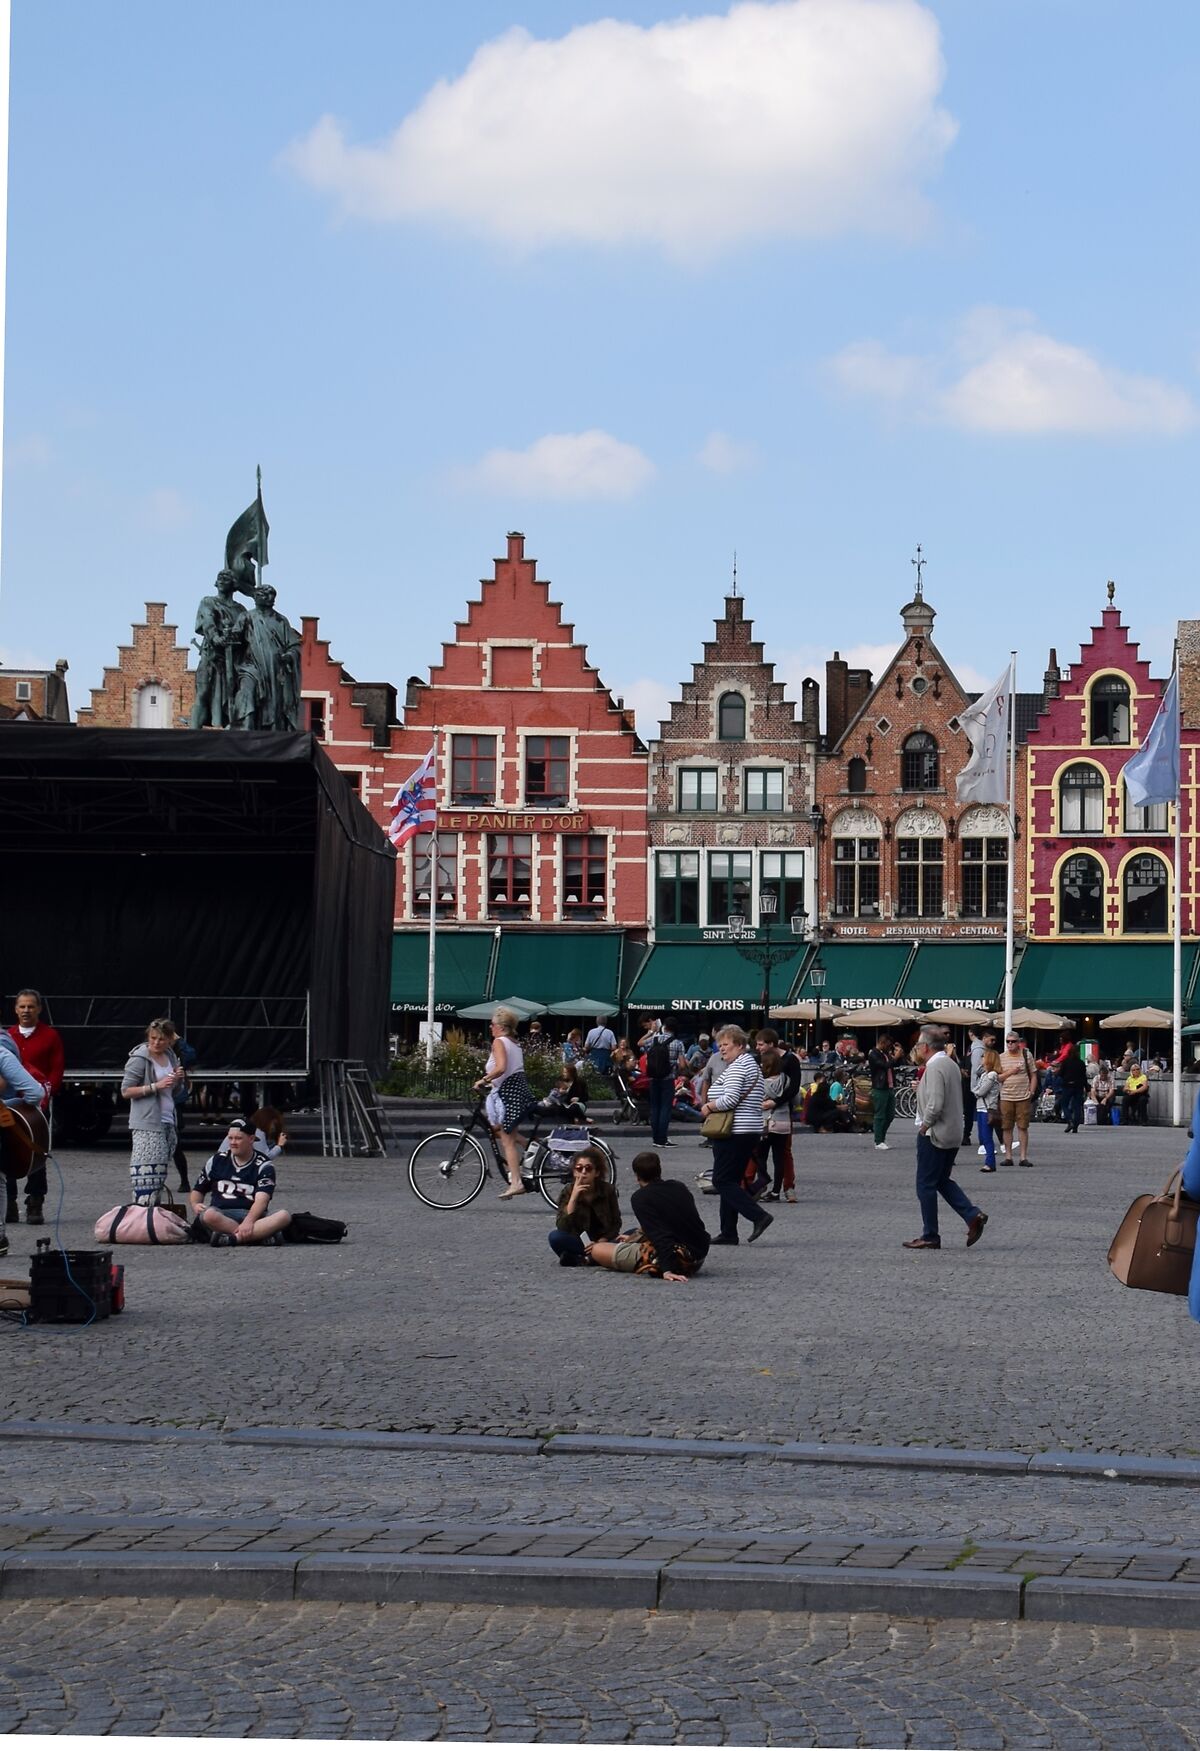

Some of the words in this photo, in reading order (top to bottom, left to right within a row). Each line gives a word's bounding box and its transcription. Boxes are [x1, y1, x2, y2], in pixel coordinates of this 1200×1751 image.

[438, 814, 462, 829] LE
[466, 813, 536, 829] PANIER
[703, 930, 726, 939] SINT
[840, 926, 869, 935] HOTEL
[886, 926, 943, 935] RESTAURANT
[959, 926, 1000, 935] CENTRAL
[392, 1003, 402, 1011] Le
[403, 1003, 429, 1012] Panie
[435, 1003, 456, 1012] d'Or
[671, 999, 745, 1010] SINT-JORIS
[927, 998, 995, 1010] "CENTRAL"
